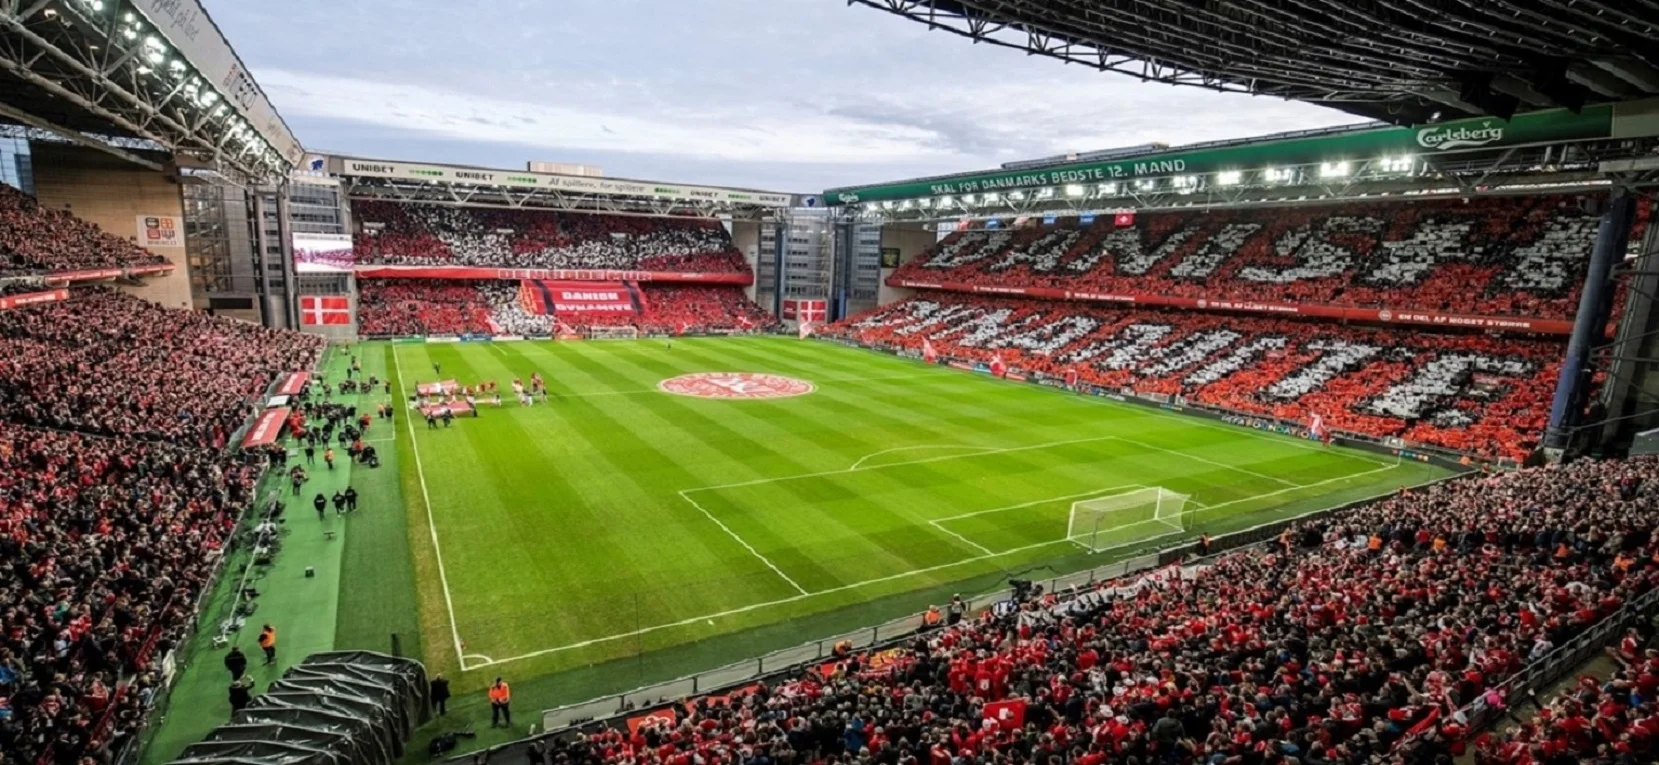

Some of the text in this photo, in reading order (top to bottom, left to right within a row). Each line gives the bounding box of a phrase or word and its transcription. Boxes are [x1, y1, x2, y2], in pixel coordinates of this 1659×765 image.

[1416, 121, 1504, 149] Carlsberg
[352, 163, 395, 174] UNIBET
[455, 171, 494, 181] UNIBET
[958, 181, 979, 193] FOR
[981, 173, 1047, 190] DANMARKS
[1051, 168, 1104, 184] BEDSTE
[1107, 166, 1128, 178] 12.
[1134, 159, 1186, 176] MAND
[561, 291, 619, 300] DANISH
